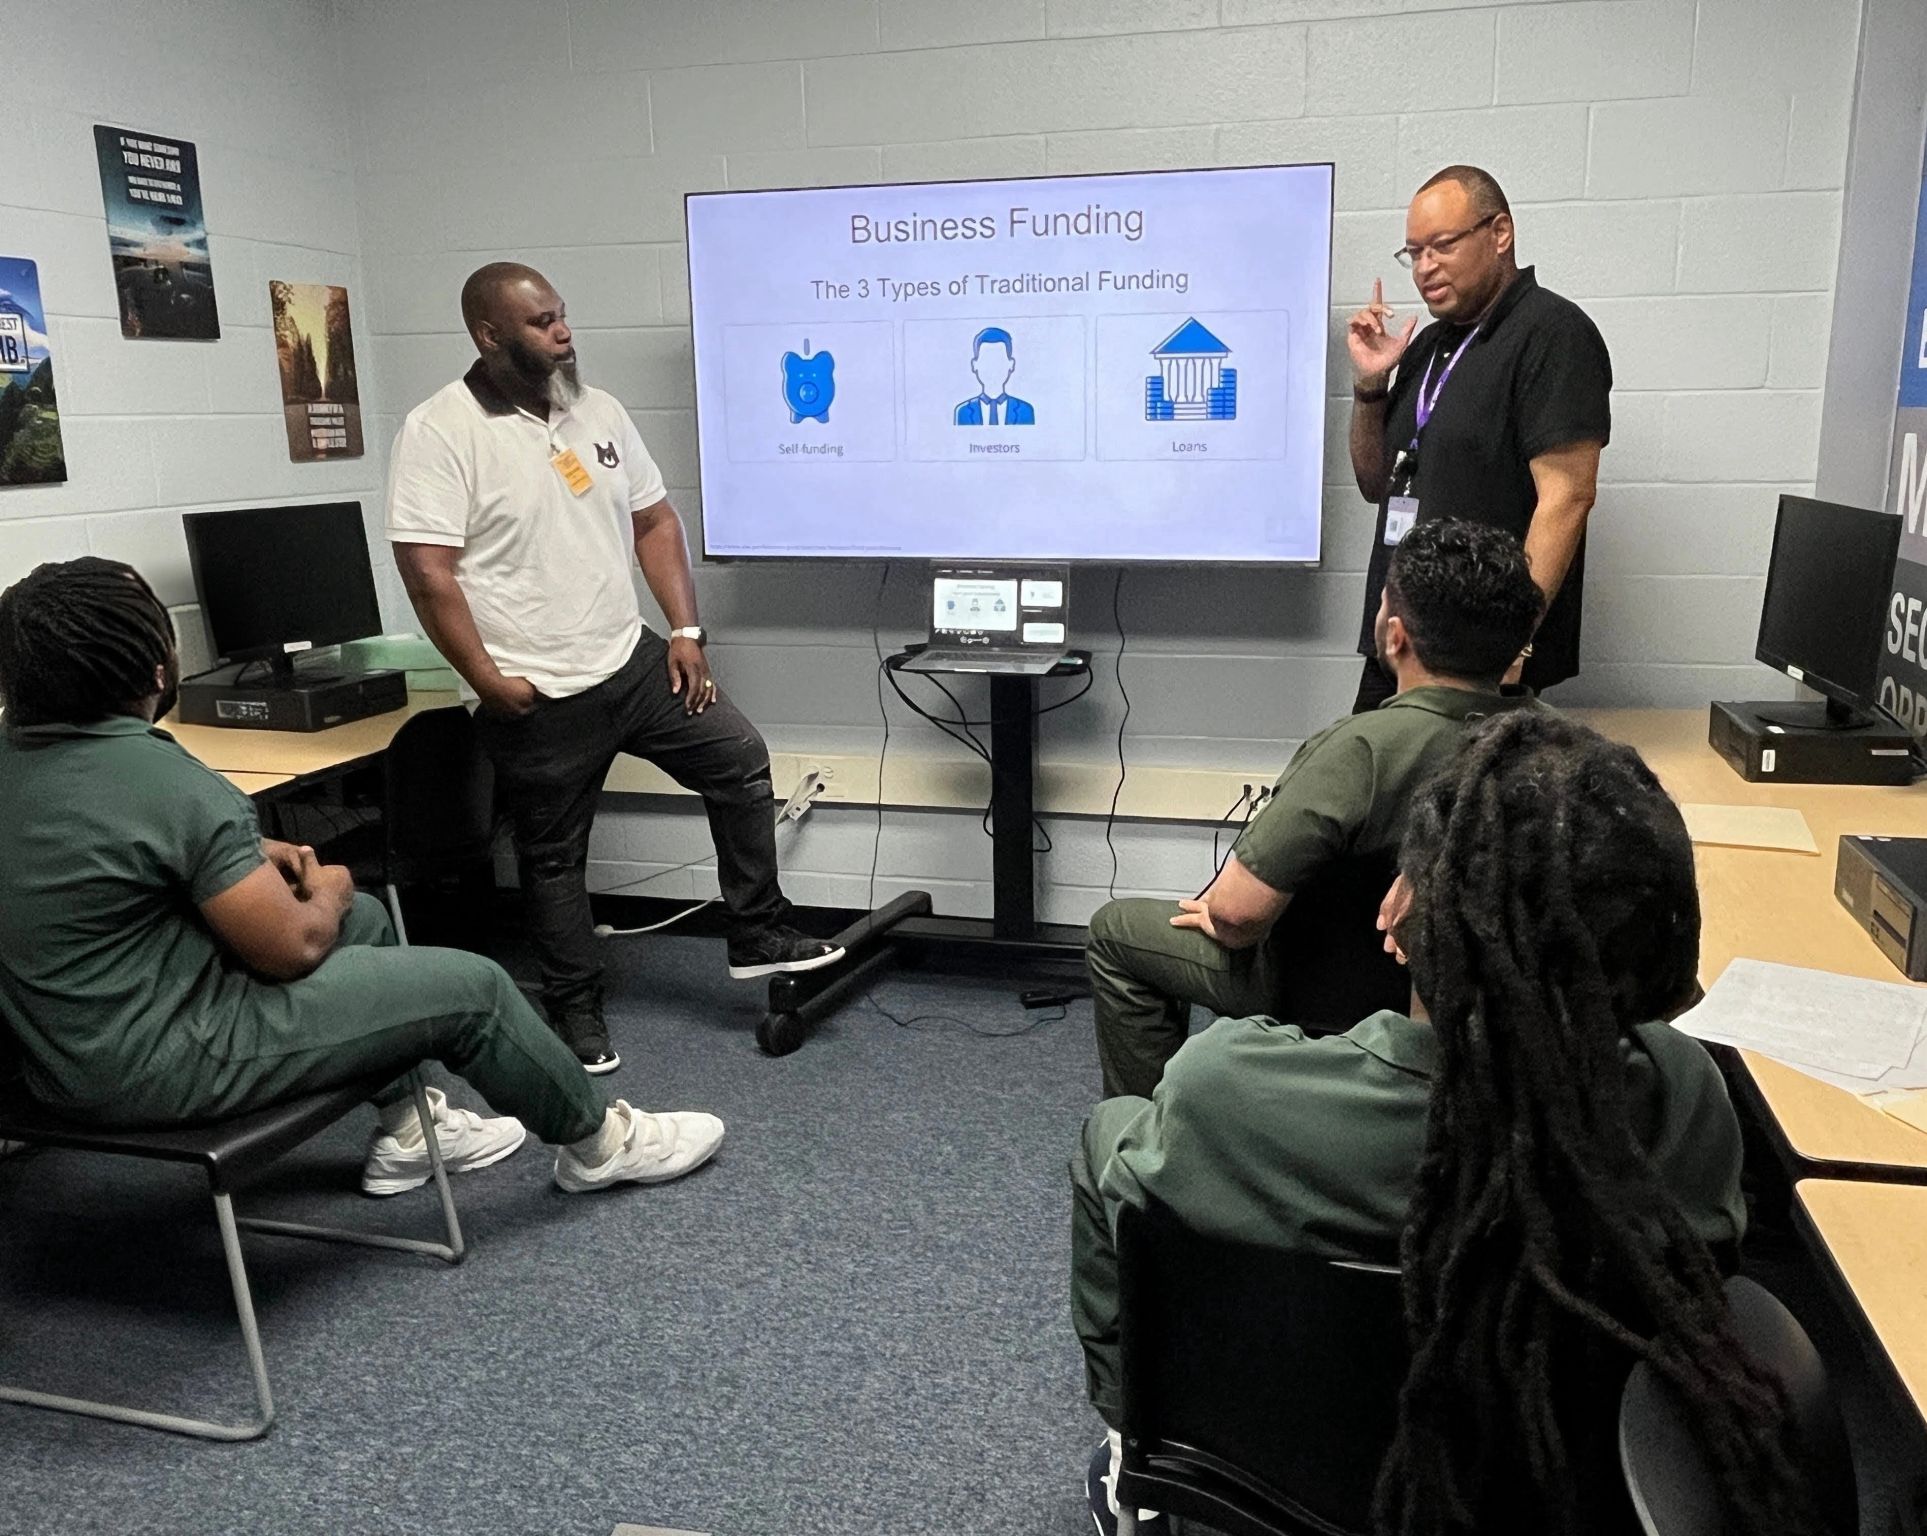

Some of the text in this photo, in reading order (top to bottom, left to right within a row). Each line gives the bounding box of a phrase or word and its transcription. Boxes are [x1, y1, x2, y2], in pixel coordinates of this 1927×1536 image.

[851, 204, 1144, 243] Business Funding
[811, 269, 1189, 302] The 3 Types of Traditional Funding
[969, 443, 1020, 454] Investors
[1172, 441, 1208, 453] Loans
